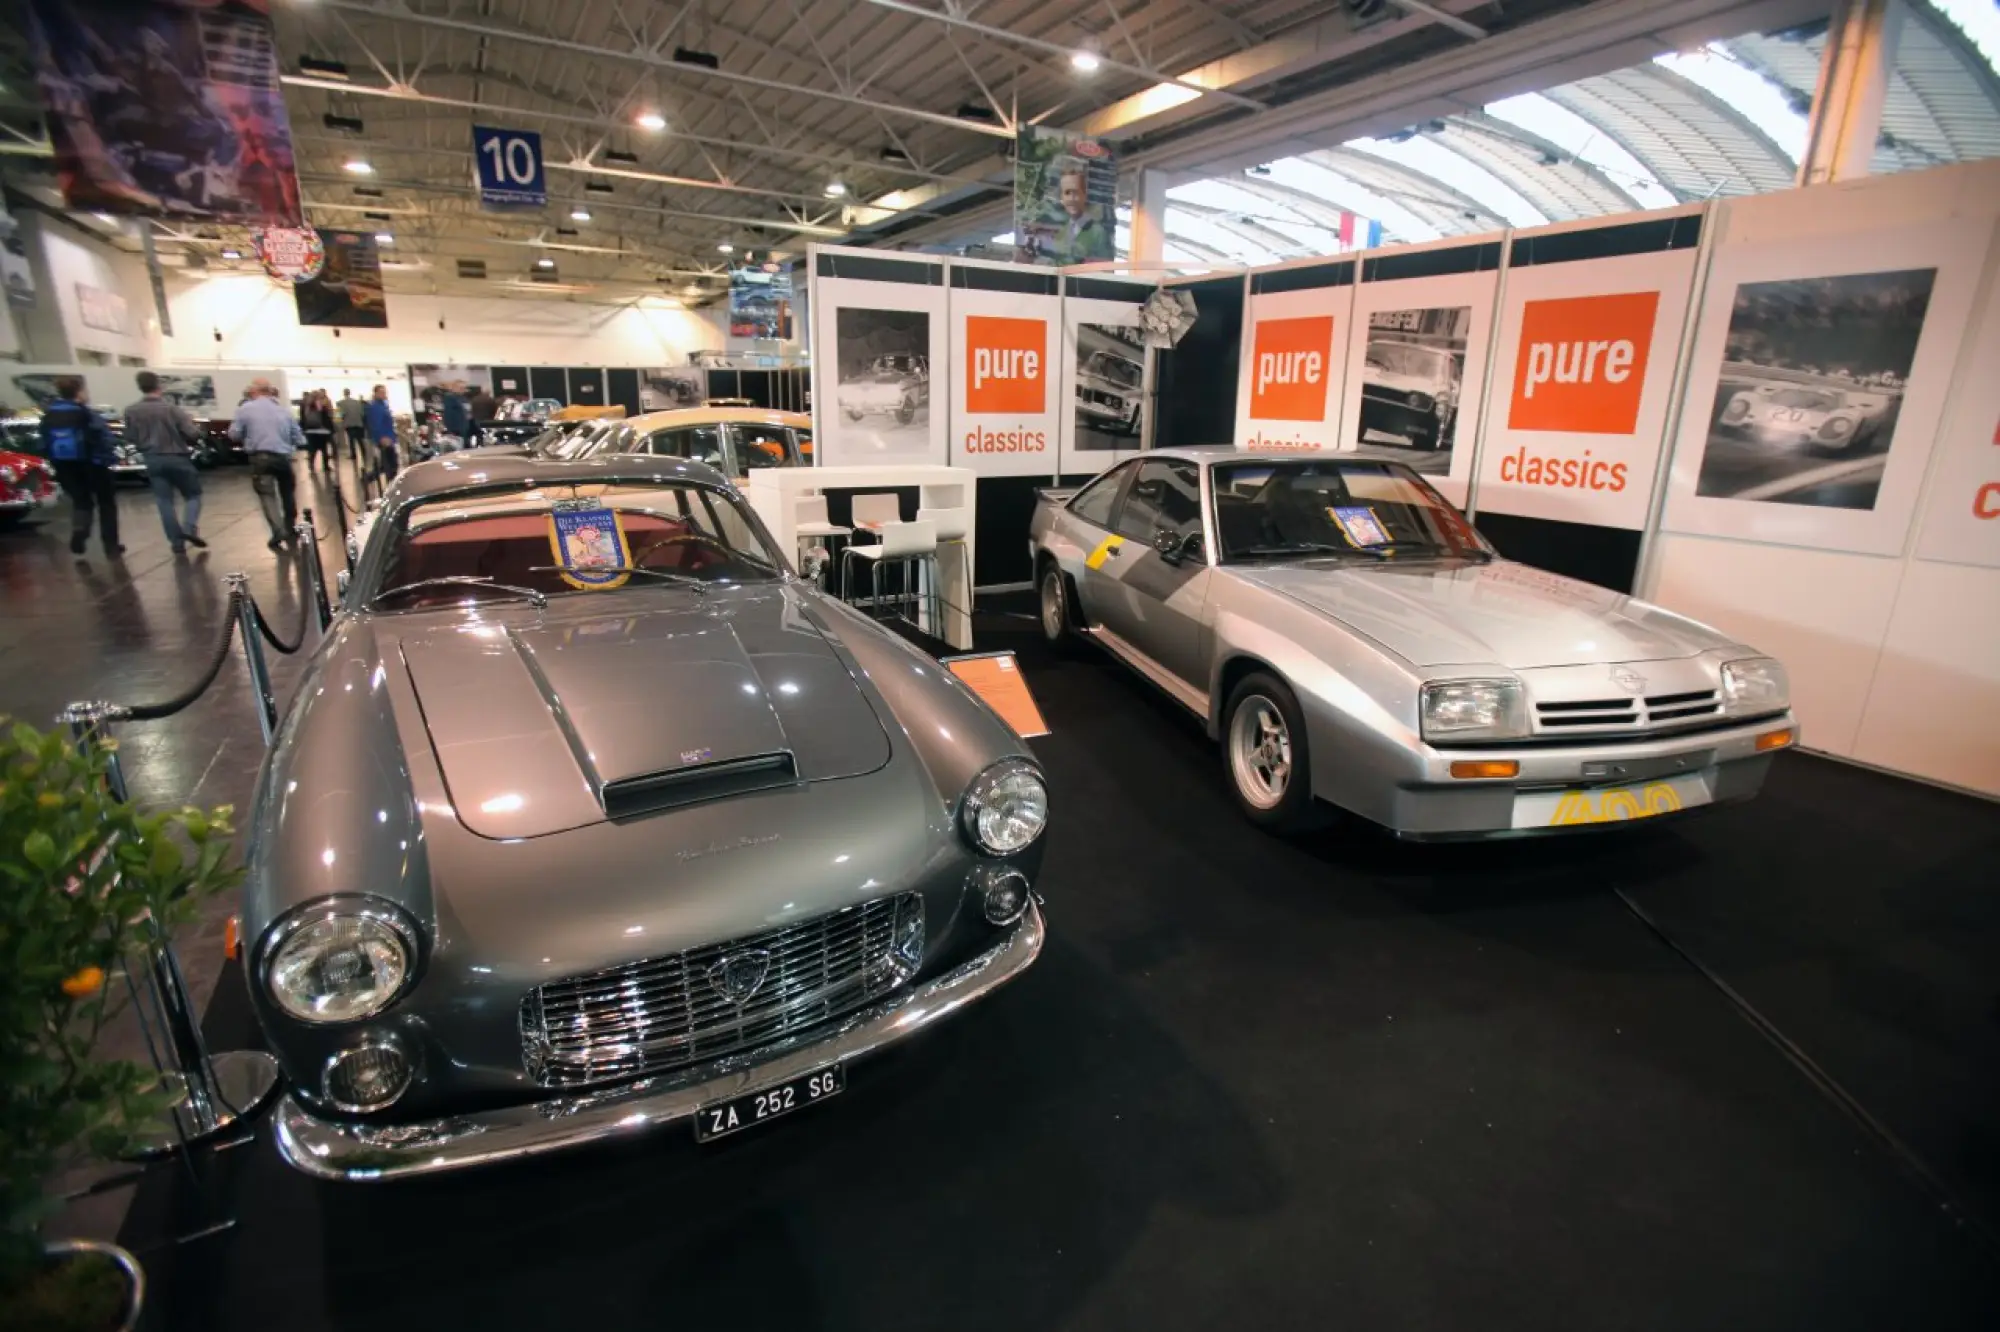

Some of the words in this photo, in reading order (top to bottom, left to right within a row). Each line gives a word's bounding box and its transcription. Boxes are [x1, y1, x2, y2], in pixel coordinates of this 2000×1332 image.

[482, 135, 536, 185] 10
[974, 347, 1039, 390] pure
[1258, 350, 1322, 396] pure
[1523, 338, 1635, 399] pure
[966, 424, 1045, 453] classics
[1500, 446, 1628, 492] classics
[710, 1105, 740, 1133] ZA
[755, 1086, 796, 1119] 252
[808, 1071, 834, 1098] SG
